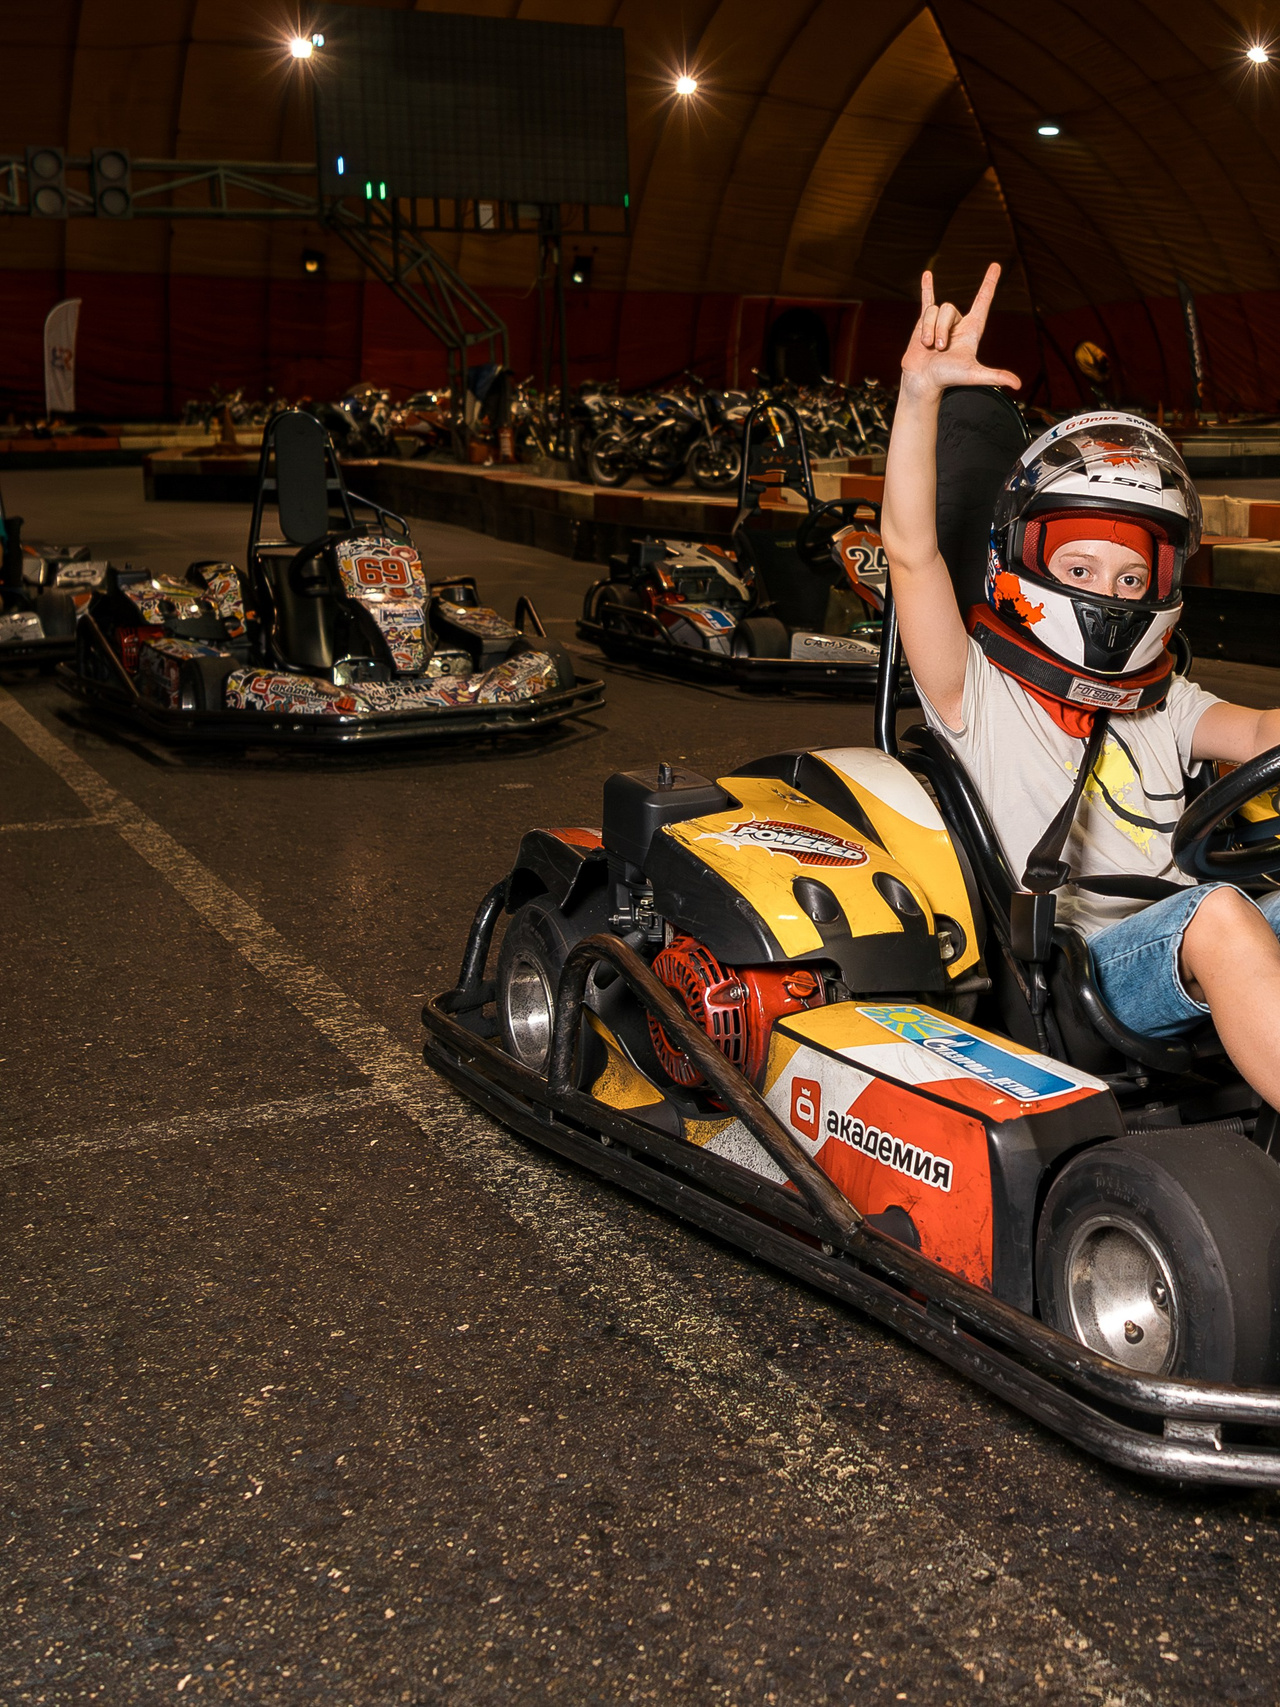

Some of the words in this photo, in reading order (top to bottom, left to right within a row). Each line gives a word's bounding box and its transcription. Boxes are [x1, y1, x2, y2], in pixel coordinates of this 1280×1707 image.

[1089, 475, 1162, 495] LS2
[356, 558, 410, 586] 69
[734, 826, 863, 861] POWERED
[826, 1110, 951, 1189] академия
